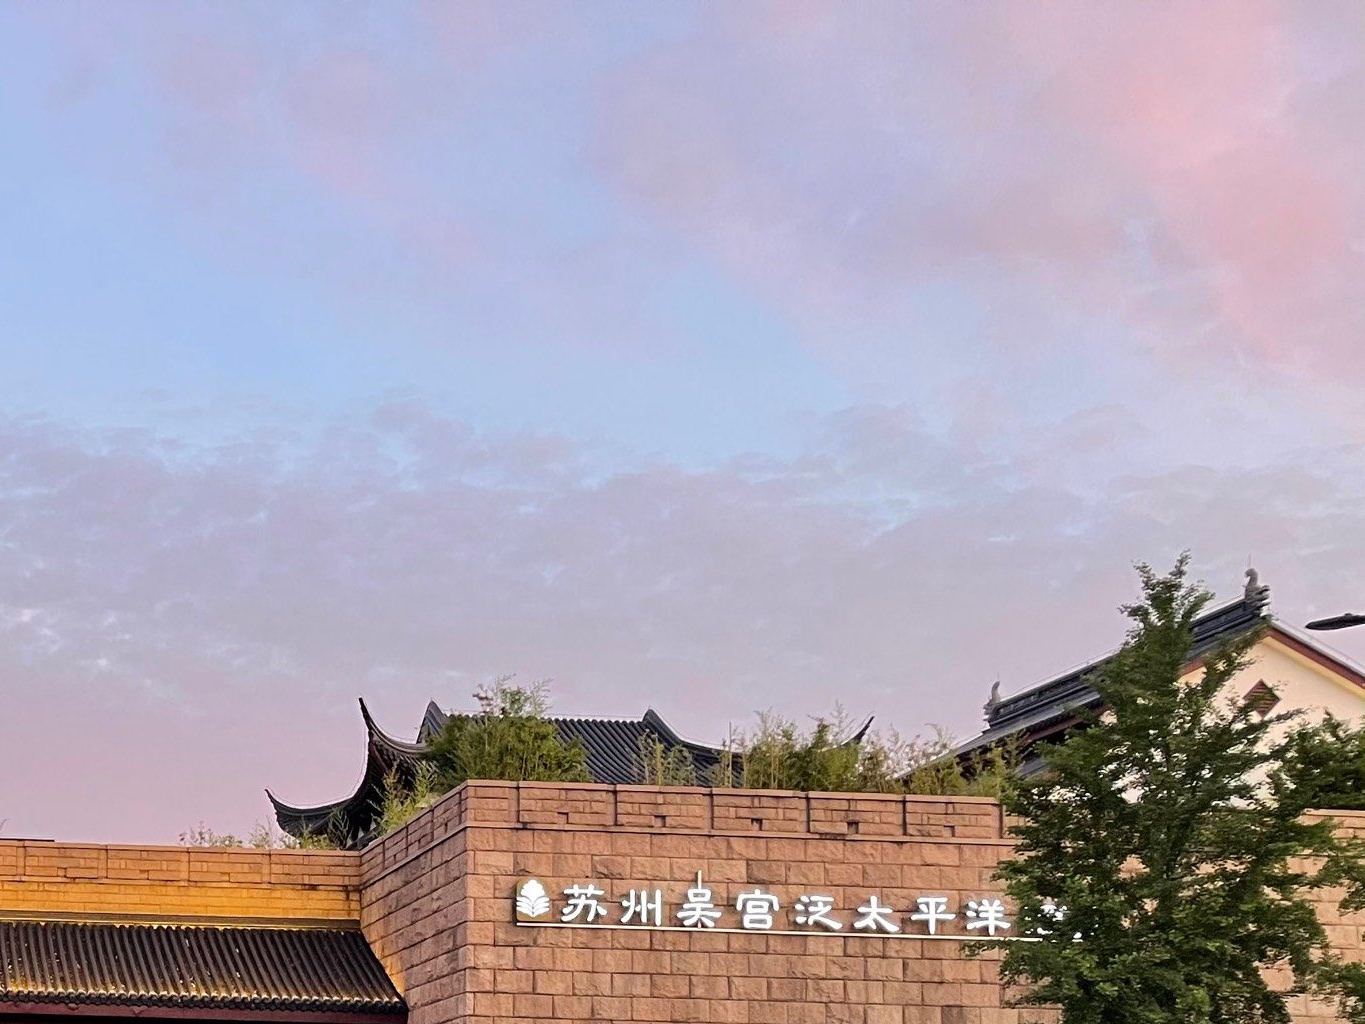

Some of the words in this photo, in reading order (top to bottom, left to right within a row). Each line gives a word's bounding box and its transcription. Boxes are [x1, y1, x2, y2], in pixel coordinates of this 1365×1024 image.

[561, 881, 1098, 937] 苏州吴宫泛太平洋
